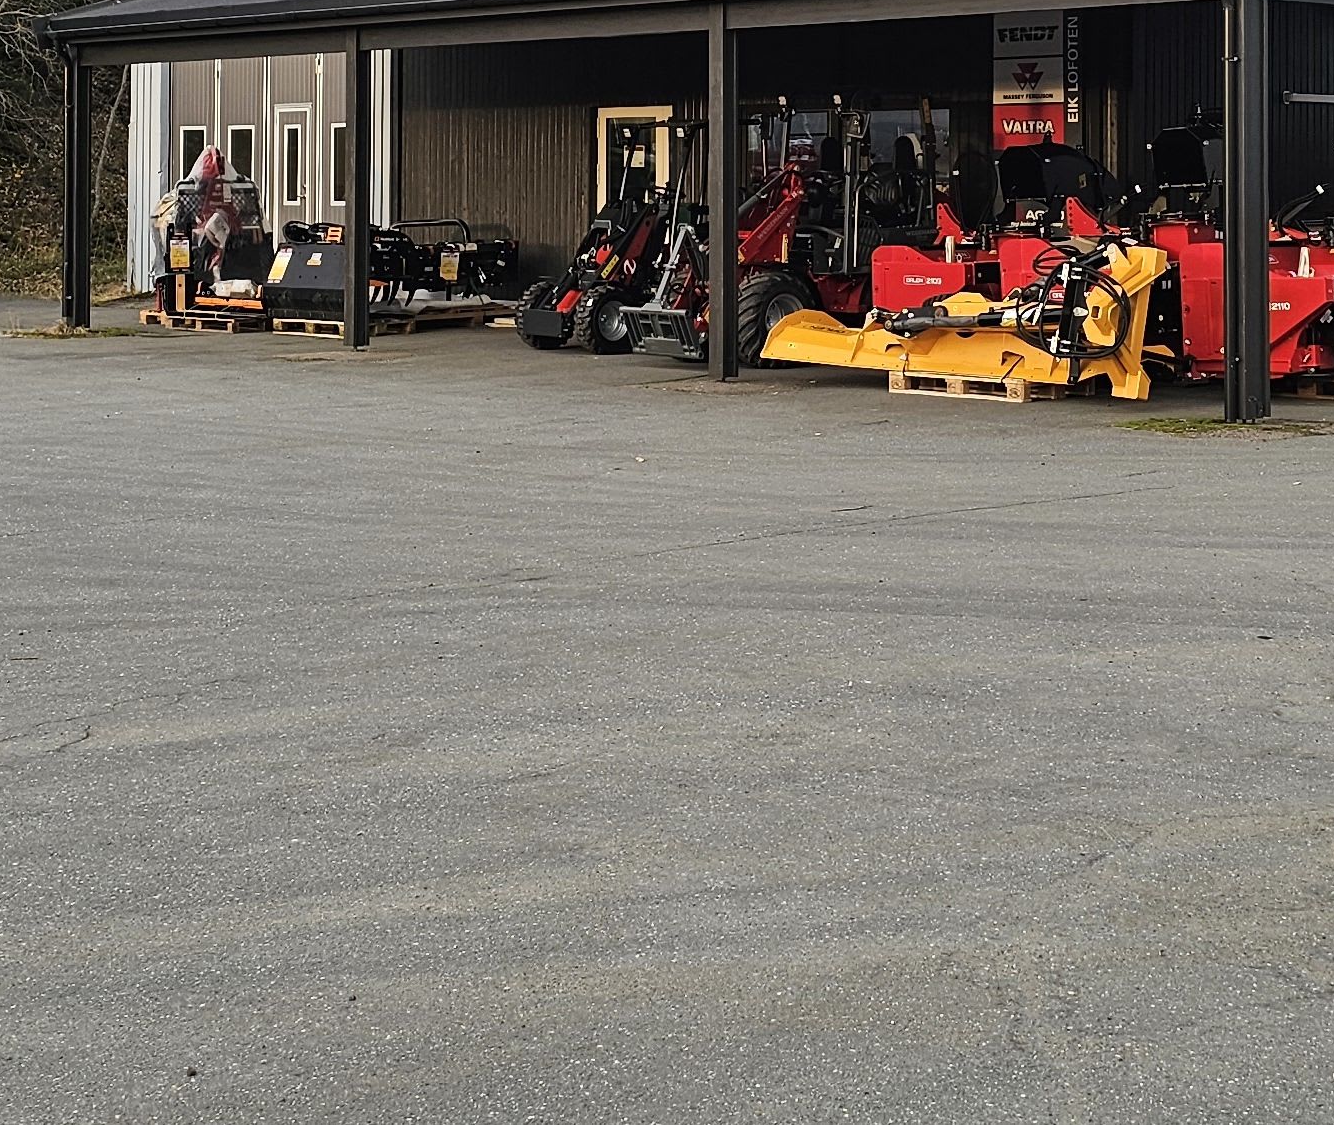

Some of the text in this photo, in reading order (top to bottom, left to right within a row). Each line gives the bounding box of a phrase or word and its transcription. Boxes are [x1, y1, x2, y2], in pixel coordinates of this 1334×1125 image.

[997, 26, 1059, 43] FENDT
[1067, 16, 1078, 123] EIK LOFOTEN
[1002, 120, 1054, 134] VALTRA
